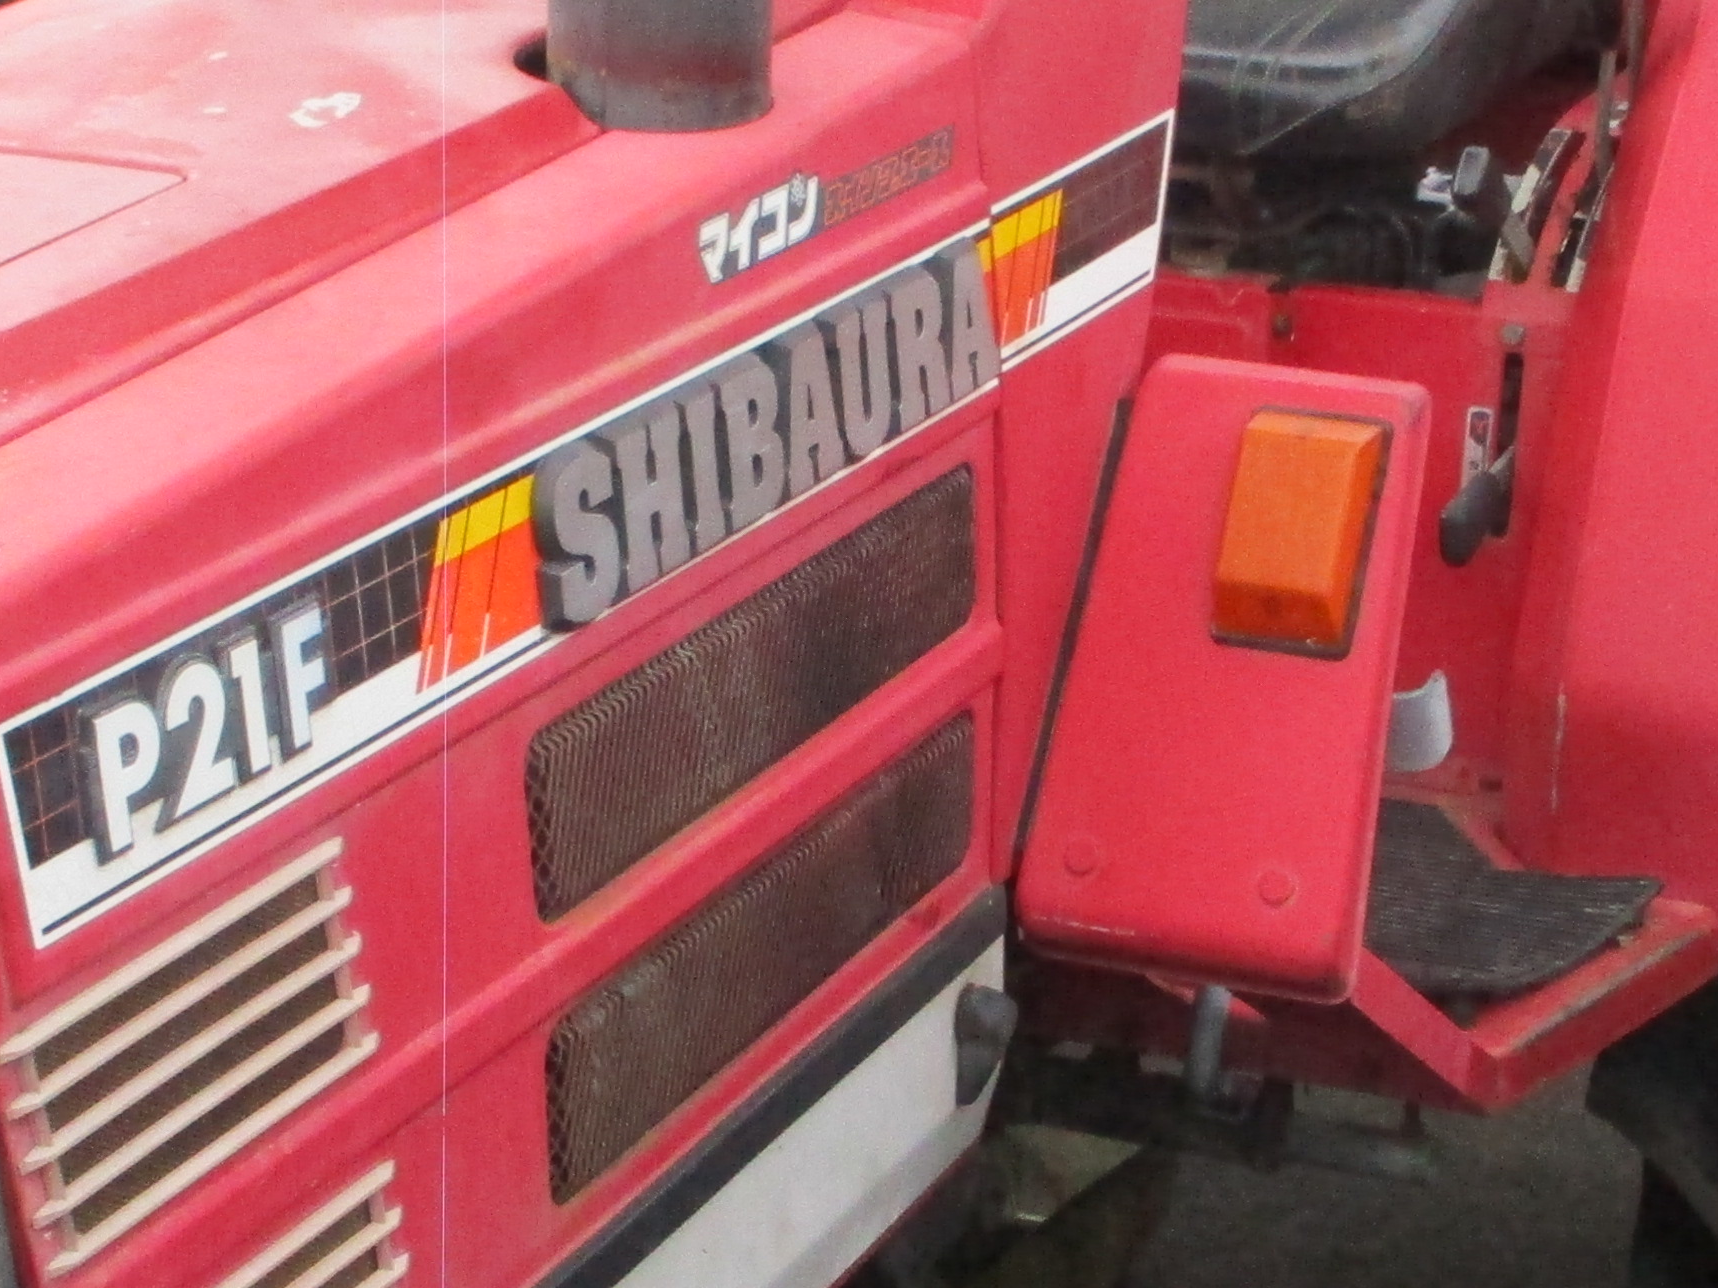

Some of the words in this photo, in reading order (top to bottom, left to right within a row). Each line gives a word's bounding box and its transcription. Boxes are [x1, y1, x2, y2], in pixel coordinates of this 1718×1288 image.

[699, 172, 819, 283] マイコン
[532, 237, 1001, 631] SHIBAURA
[85, 598, 329, 860] P21F
